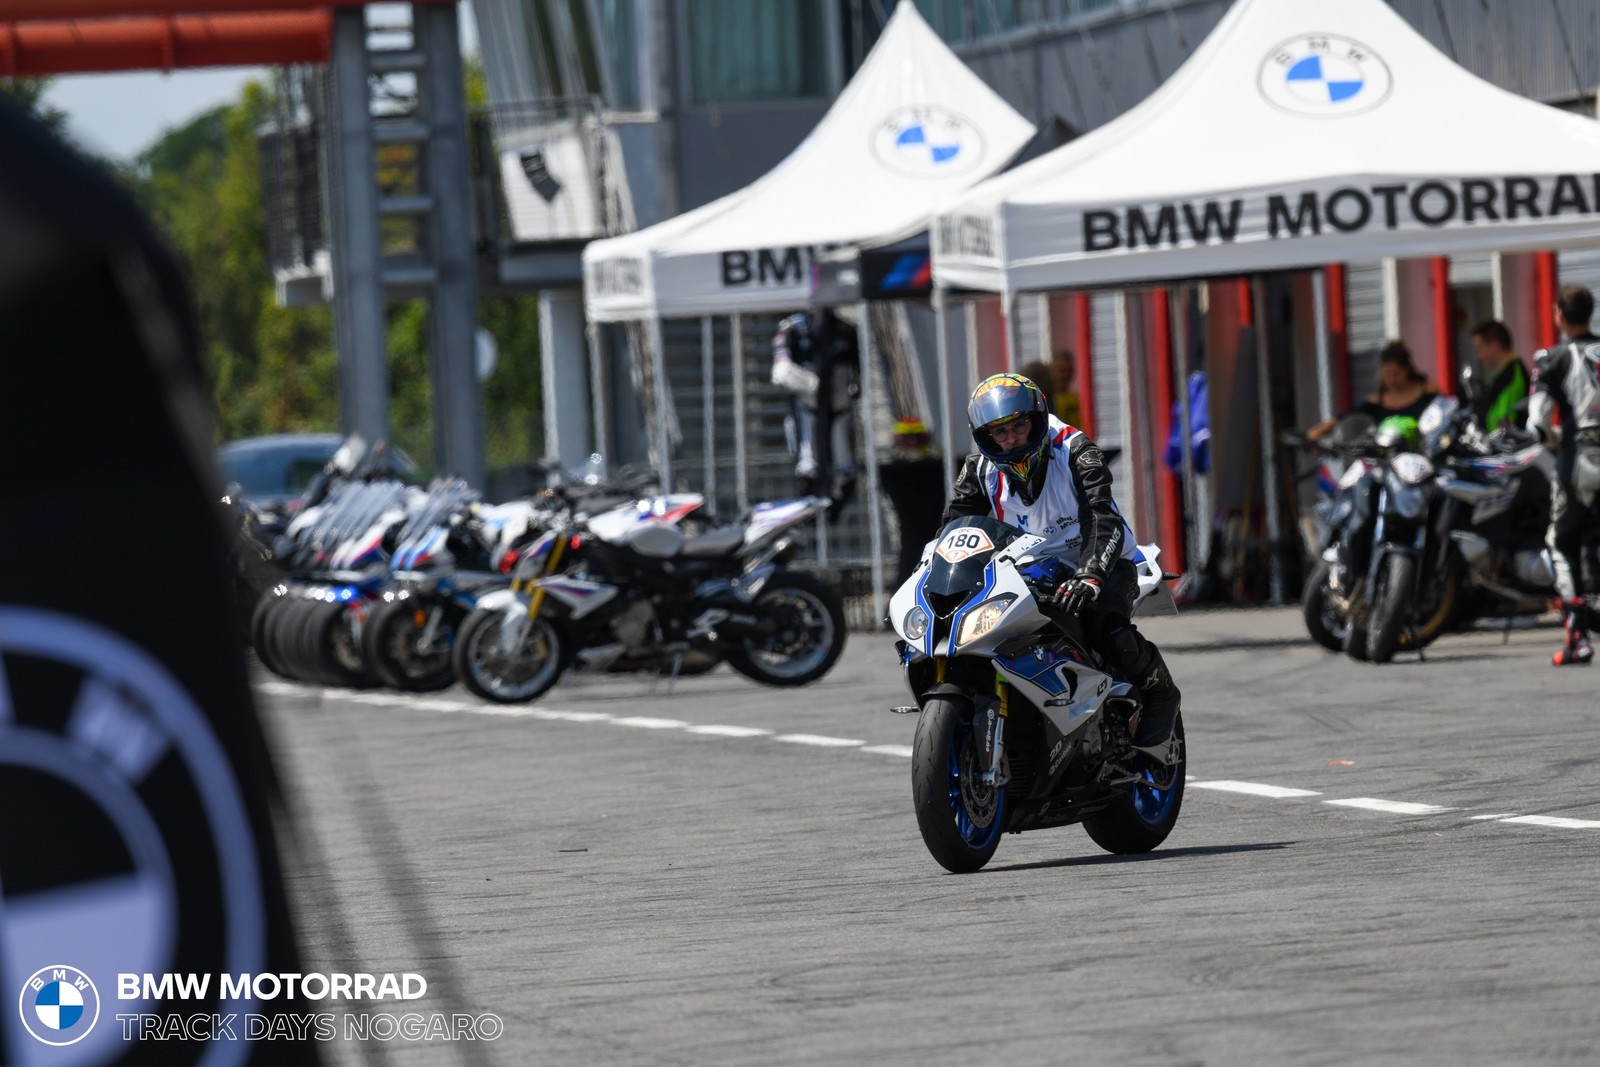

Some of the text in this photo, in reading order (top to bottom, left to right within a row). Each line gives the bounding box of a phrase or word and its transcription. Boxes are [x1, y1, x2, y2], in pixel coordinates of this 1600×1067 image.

[1083, 172, 1600, 252] BMW MOTORRA
[946, 534, 980, 549] 180
